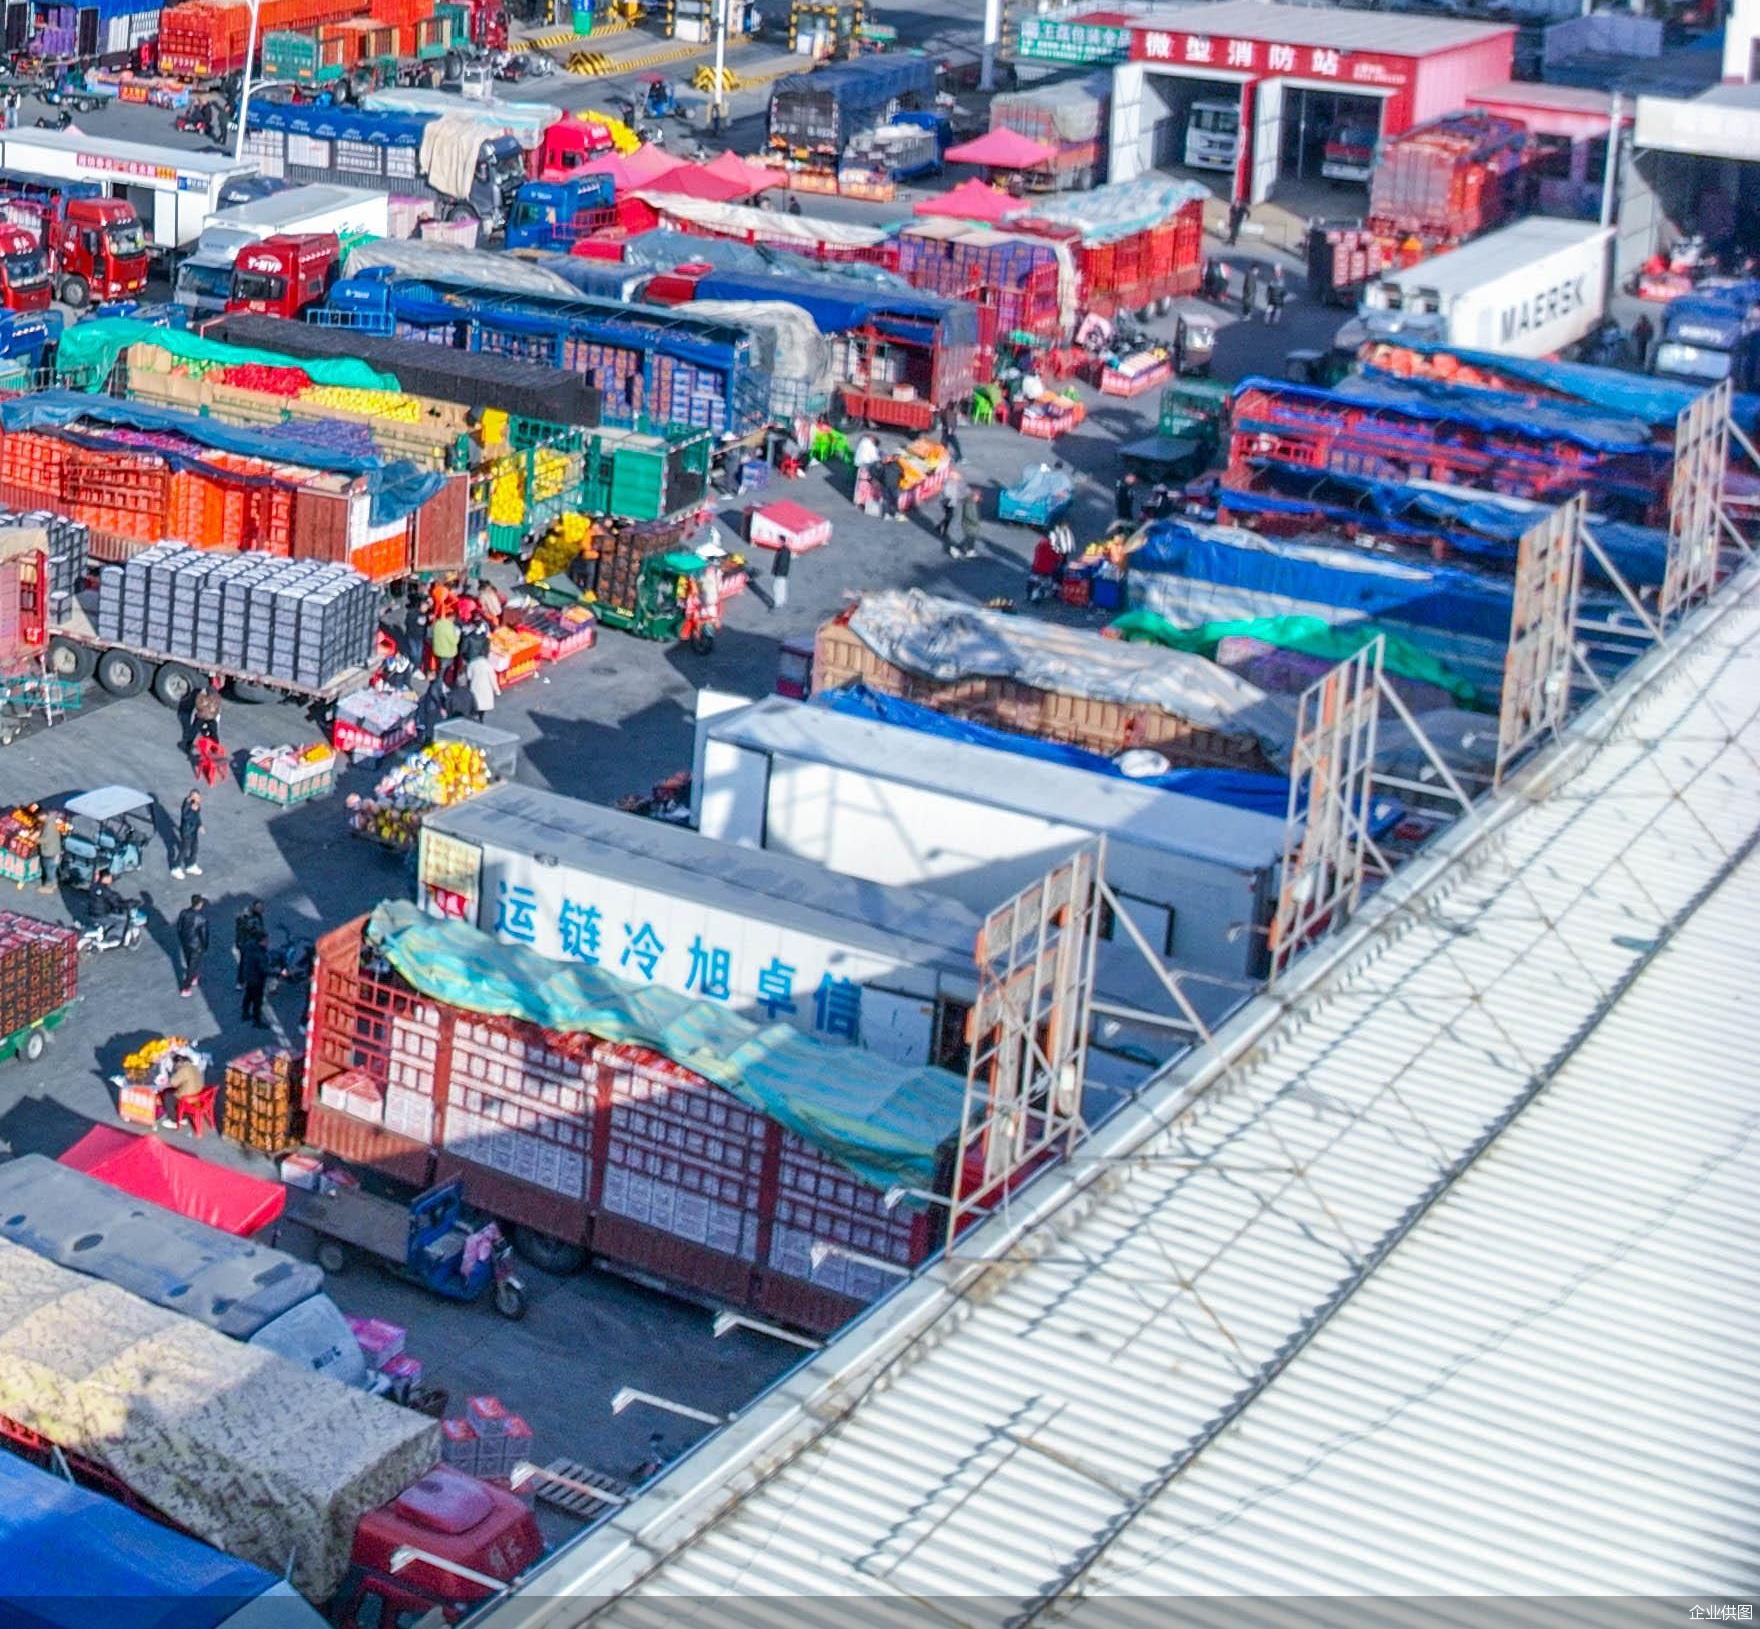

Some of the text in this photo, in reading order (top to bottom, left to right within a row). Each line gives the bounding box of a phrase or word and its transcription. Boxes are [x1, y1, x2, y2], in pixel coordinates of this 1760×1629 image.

[1144, 31, 1340, 76] 微型消防站
[1501, 275, 1585, 344] MAERSK
